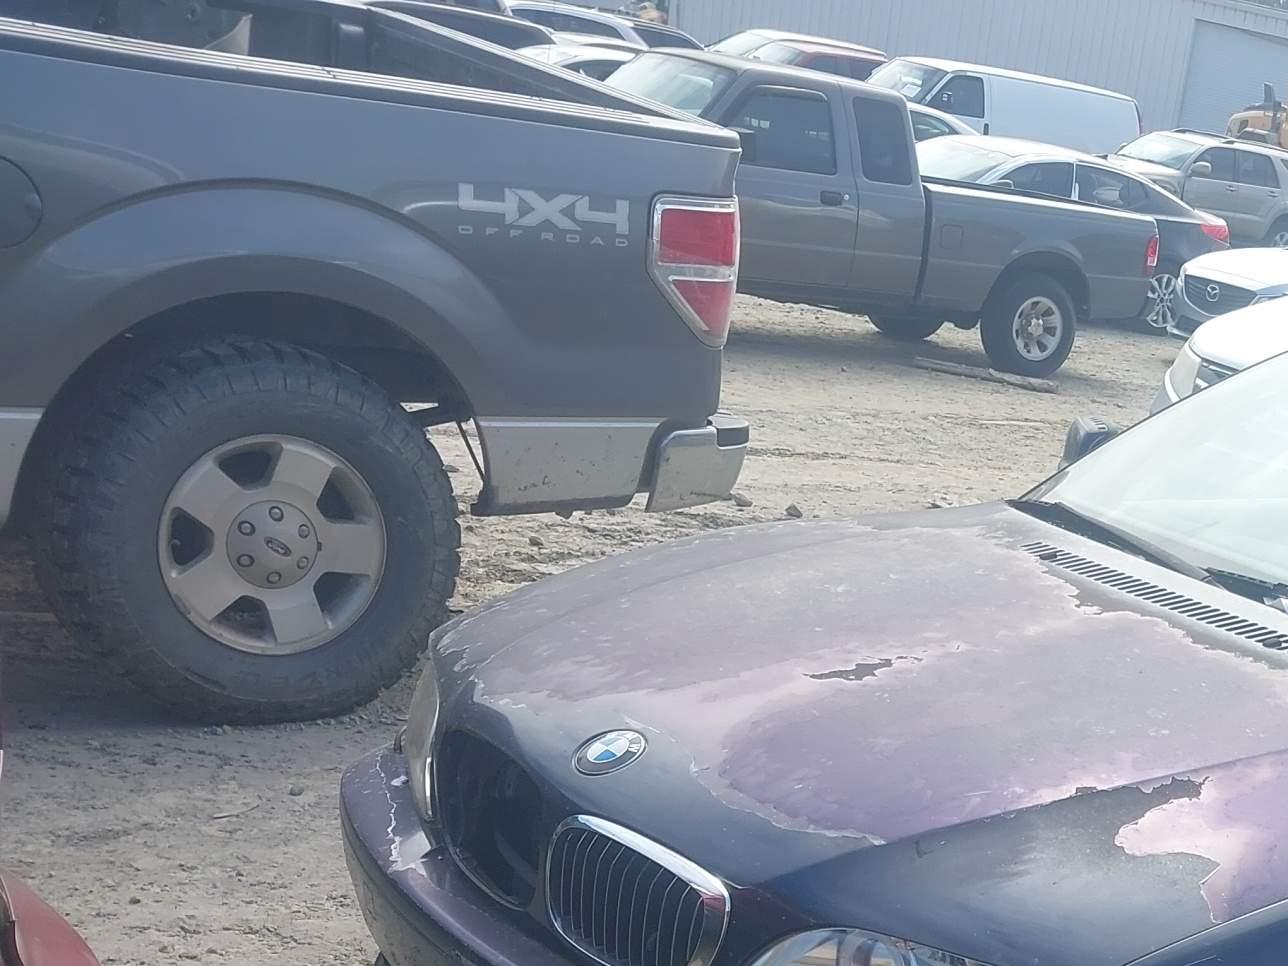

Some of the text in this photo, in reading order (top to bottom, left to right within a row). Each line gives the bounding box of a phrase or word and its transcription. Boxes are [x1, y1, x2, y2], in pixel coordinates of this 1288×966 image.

[458, 183, 630, 236] 4X4
[458, 225, 629, 248] OFF ROAD
